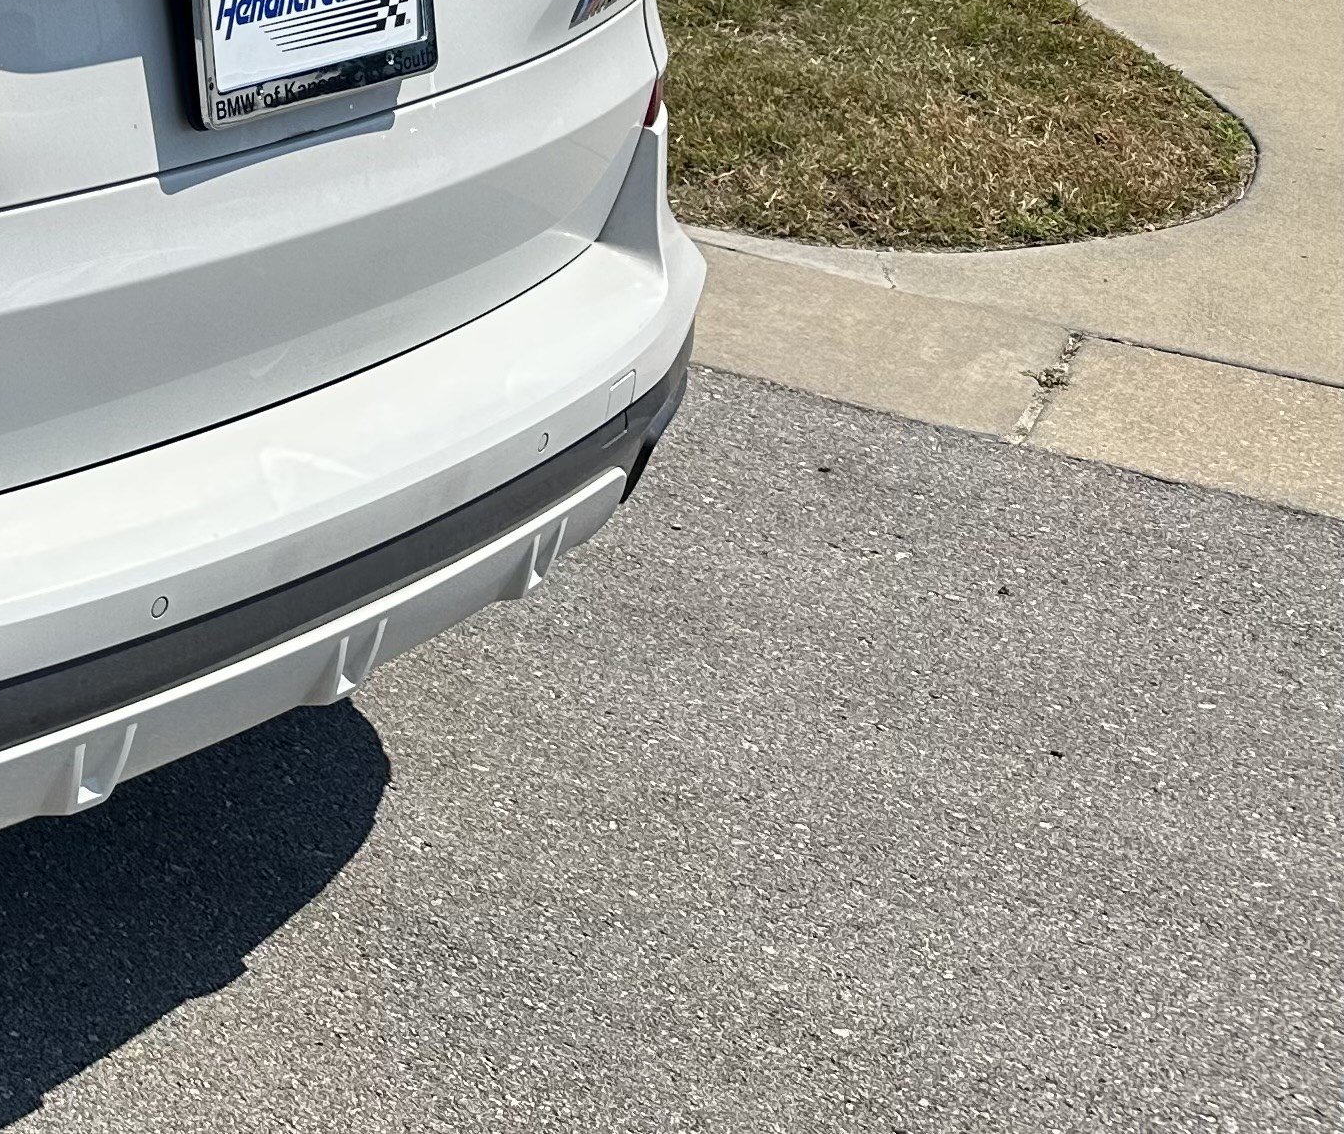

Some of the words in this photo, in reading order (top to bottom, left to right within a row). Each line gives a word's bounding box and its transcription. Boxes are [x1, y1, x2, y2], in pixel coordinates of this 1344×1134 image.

[216, 92, 255, 120] BMW
[264, 85, 280, 108] of
[394, 47, 436, 71] South
